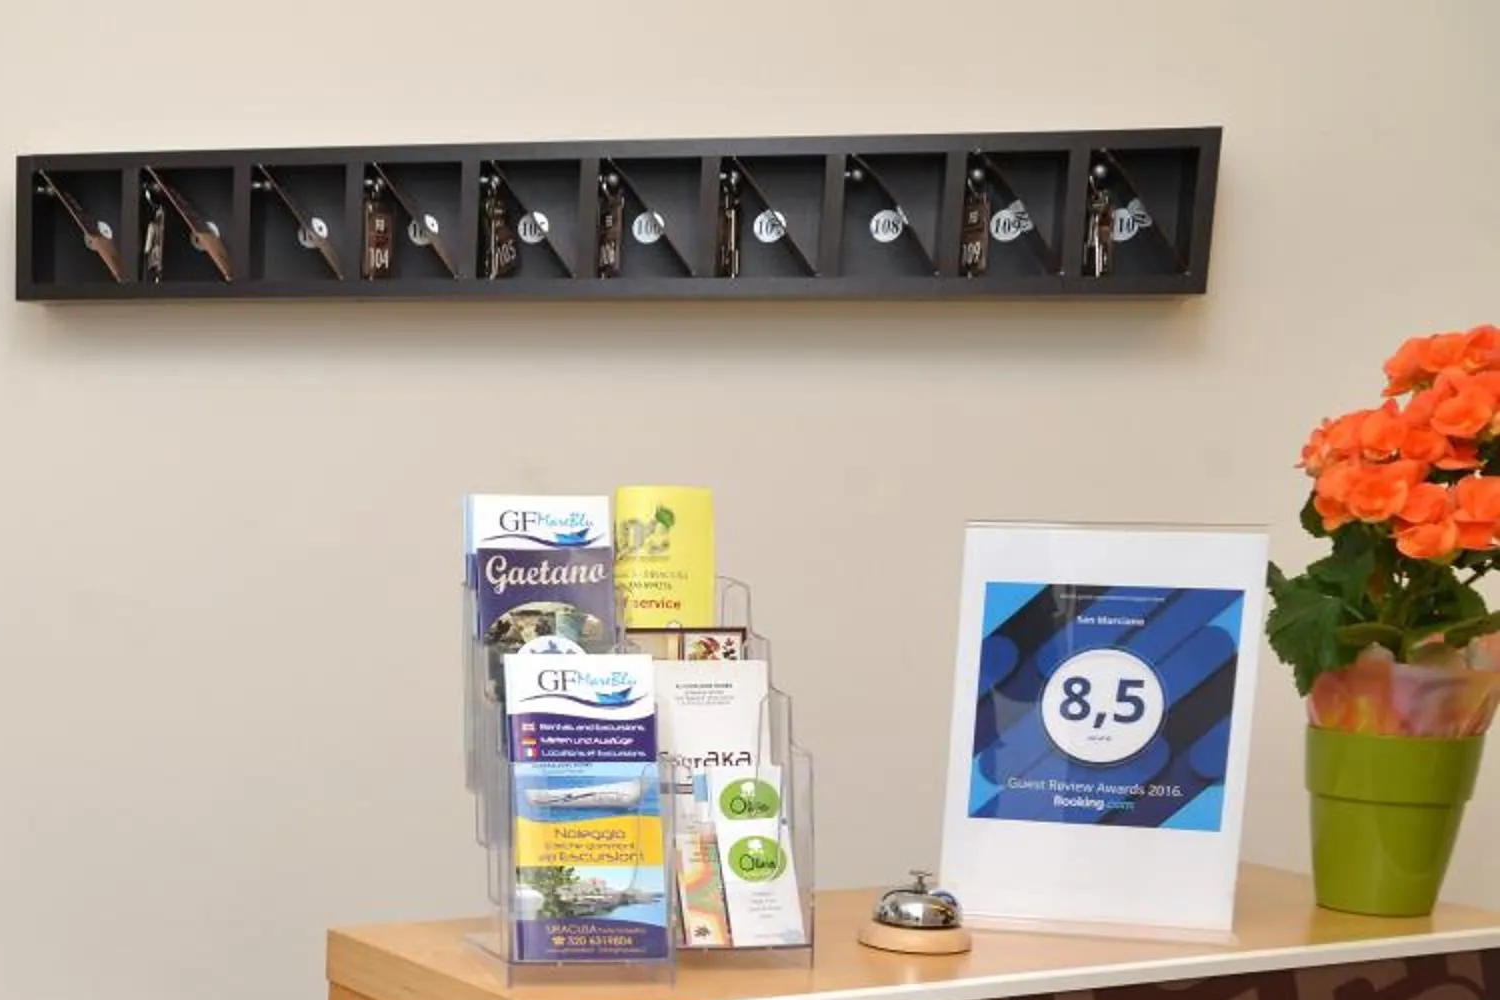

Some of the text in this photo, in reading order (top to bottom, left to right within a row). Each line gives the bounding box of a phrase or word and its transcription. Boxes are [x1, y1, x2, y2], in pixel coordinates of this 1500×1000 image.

[499, 509, 537, 532] GF
[485, 555, 608, 595] Gaetano
[537, 669, 576, 692] GF
[1059, 676, 1146, 730] 8,5
[1007, 777, 1046, 790] Guest
[1048, 779, 1095, 793] Review
[1096, 782, 1145, 796] Awards
